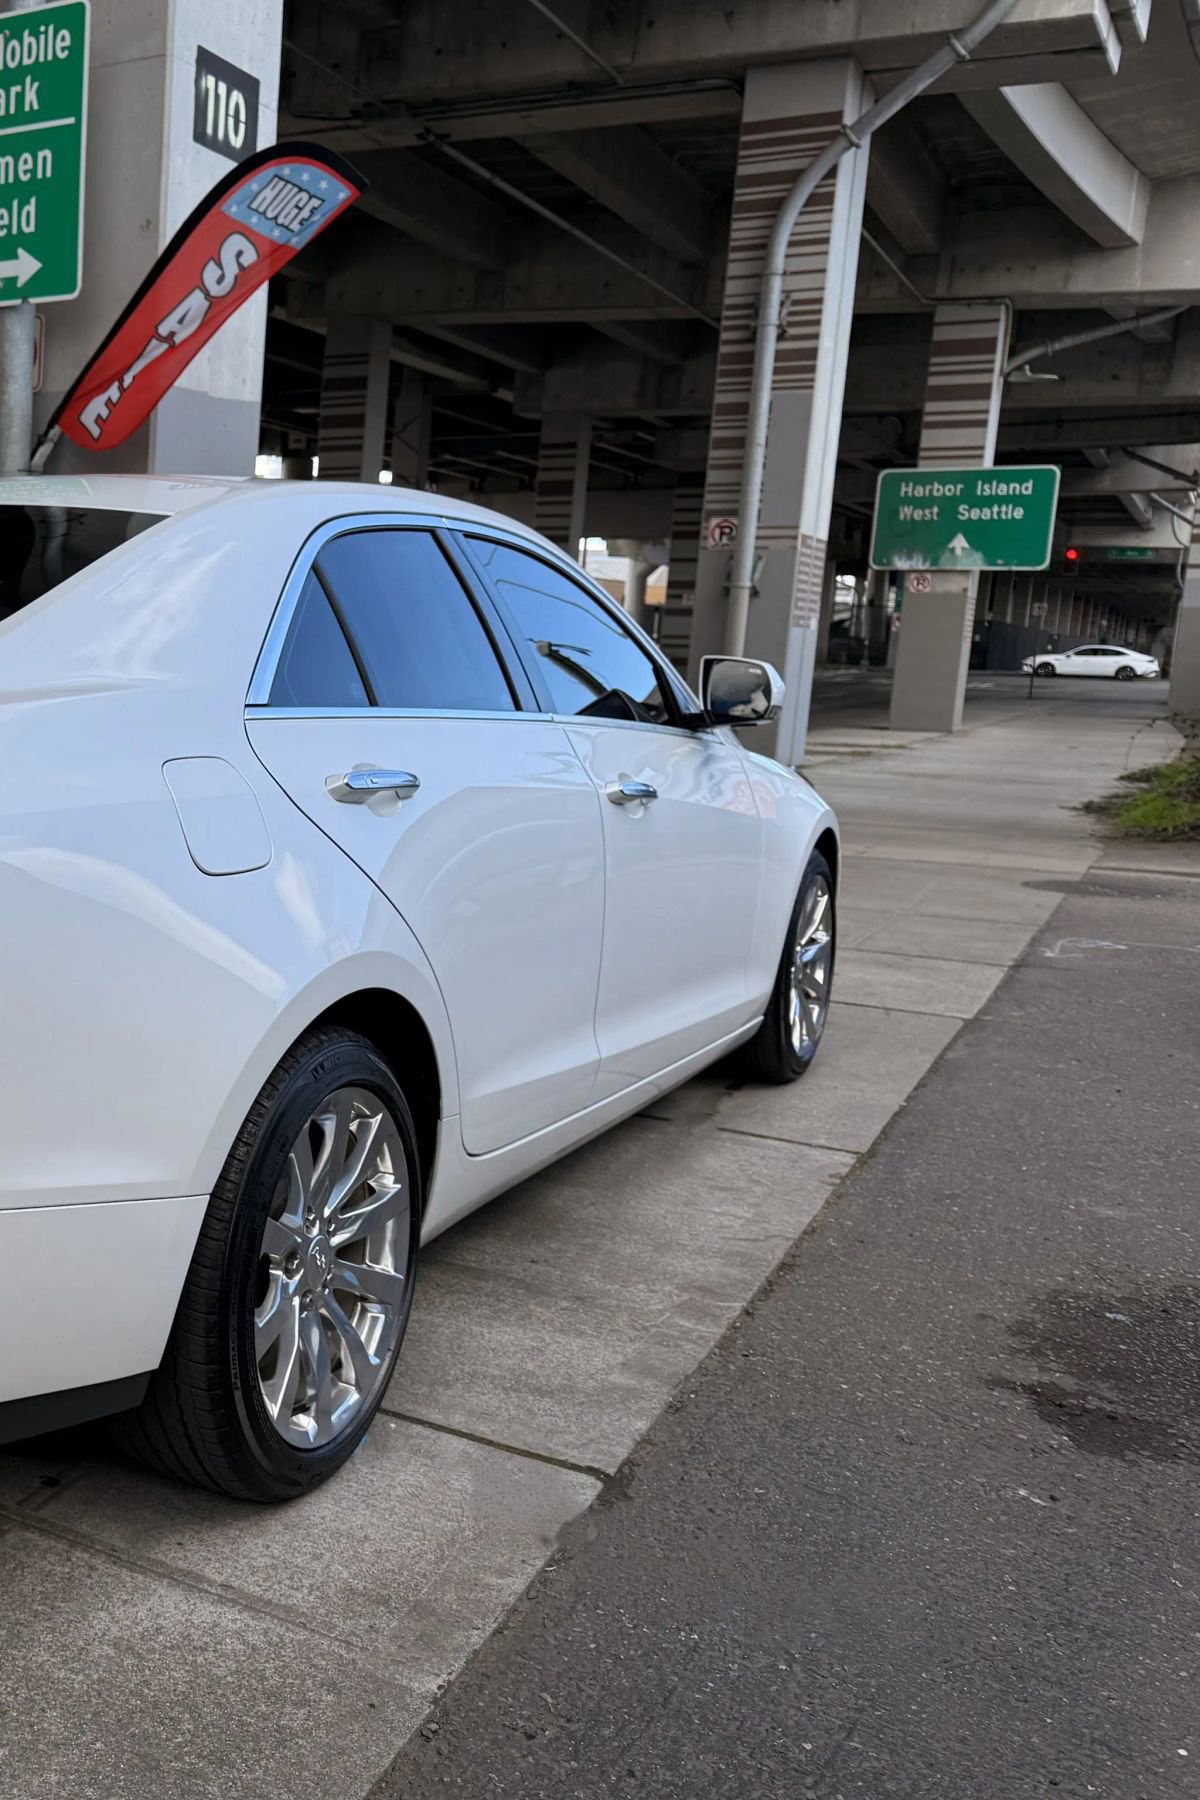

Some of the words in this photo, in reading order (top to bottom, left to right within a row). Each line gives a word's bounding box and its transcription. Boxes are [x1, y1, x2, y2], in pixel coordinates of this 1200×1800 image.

[206, 74, 247, 150] 110
[248, 174, 325, 233] HUGE
[78, 231, 259, 441] SALE
[899, 505, 939, 520] West
[957, 504, 1024, 520] Seattle
[900, 481, 964, 497] Harbor
[976, 479, 1033, 496] Island
